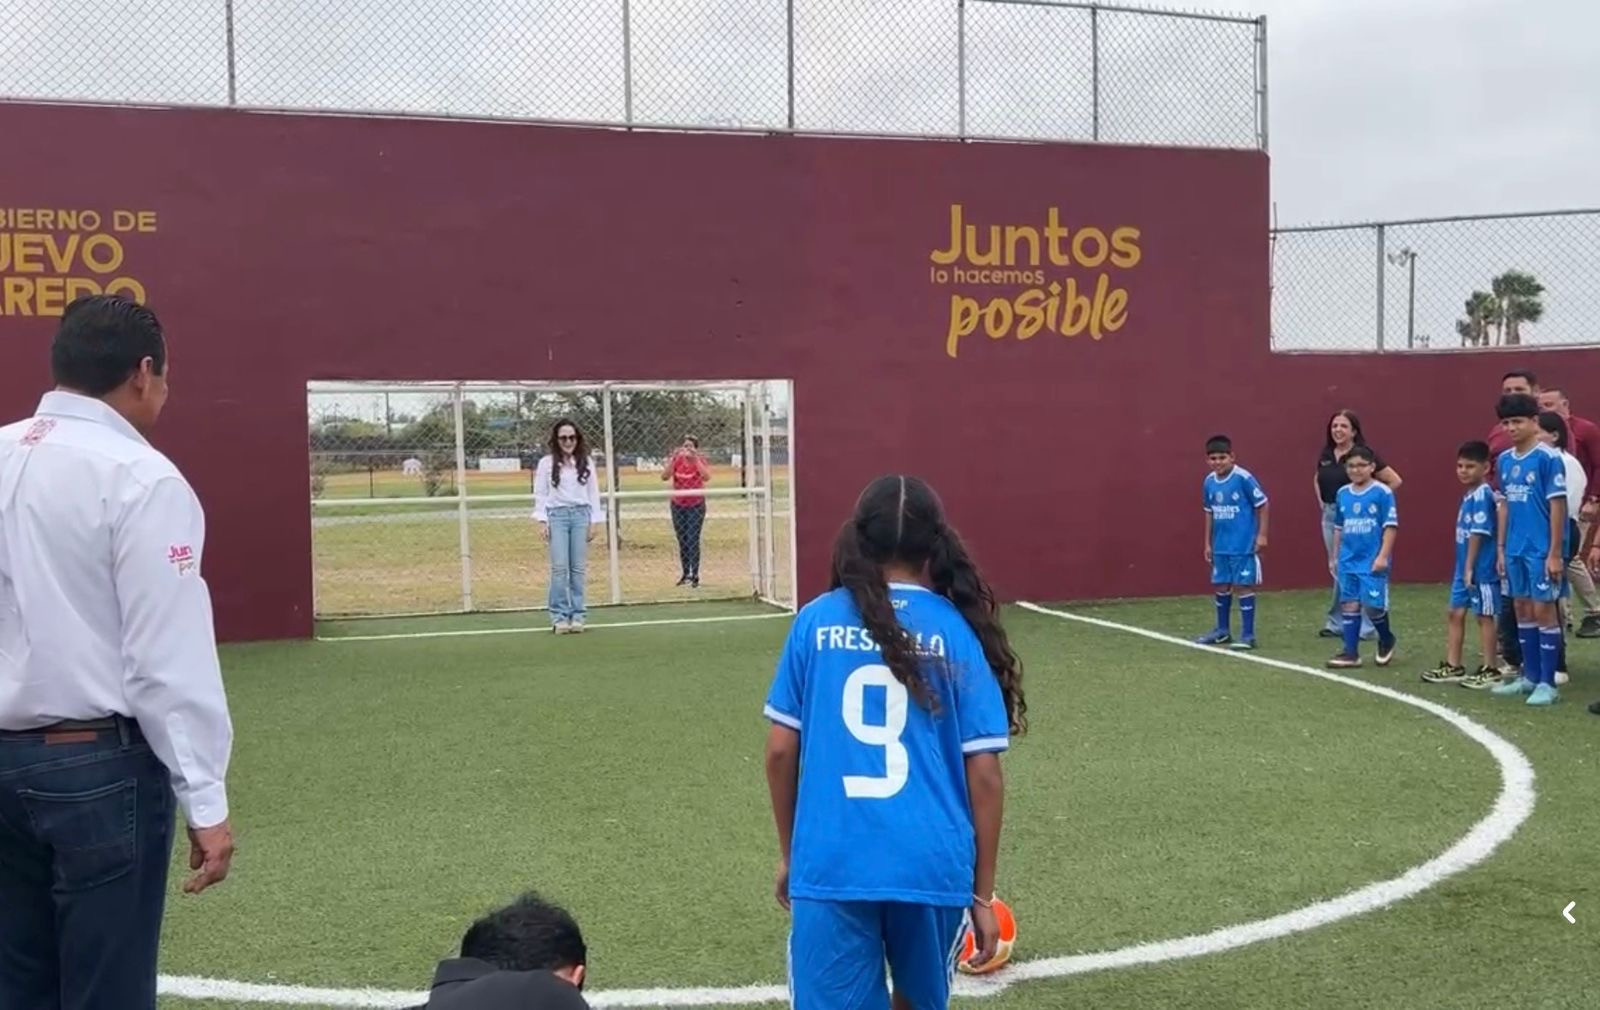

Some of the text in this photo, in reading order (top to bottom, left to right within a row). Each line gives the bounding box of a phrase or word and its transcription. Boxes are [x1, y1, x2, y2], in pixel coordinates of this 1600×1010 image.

[113, 210, 157, 232] DE
[930, 204, 1142, 268] Juntos
[0, 277, 146, 316] REDO
[930, 267, 1045, 285] lo hacemos
[946, 273, 1129, 358] posible
[842, 664, 910, 799] 9
